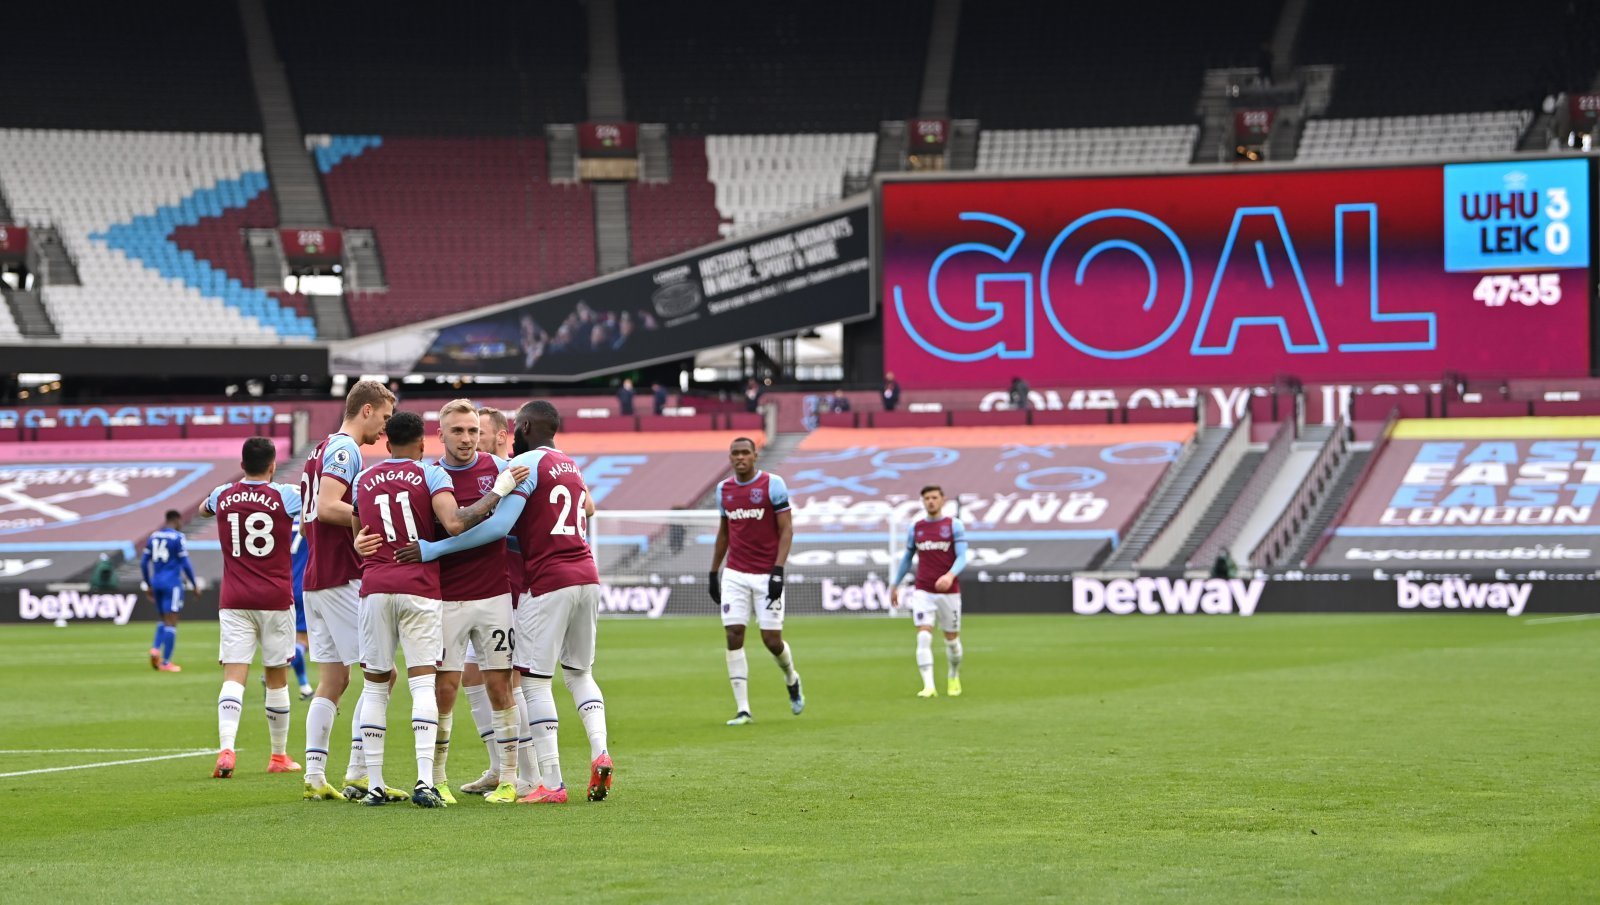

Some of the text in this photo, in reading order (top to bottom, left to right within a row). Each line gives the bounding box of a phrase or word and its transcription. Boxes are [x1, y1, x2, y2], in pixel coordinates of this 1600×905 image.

[1461, 187, 1570, 221] WHU 3
[1481, 221, 1570, 255] LEIC 0
[894, 203, 1437, 362] GOAL
[1473, 273, 1562, 306] 47:35
[363, 470, 423, 492] LINGARD
[220, 491, 280, 511] P.FORNALS
[374, 491, 419, 543] 11
[1379, 506, 1592, 526] LONDON
[227, 511, 275, 557] 18
[18, 588, 138, 625] betway
[1072, 576, 1266, 617] betway
[1396, 576, 1533, 617] betway
[492, 627, 516, 652] 20
[364, 731, 383, 739] WHU
